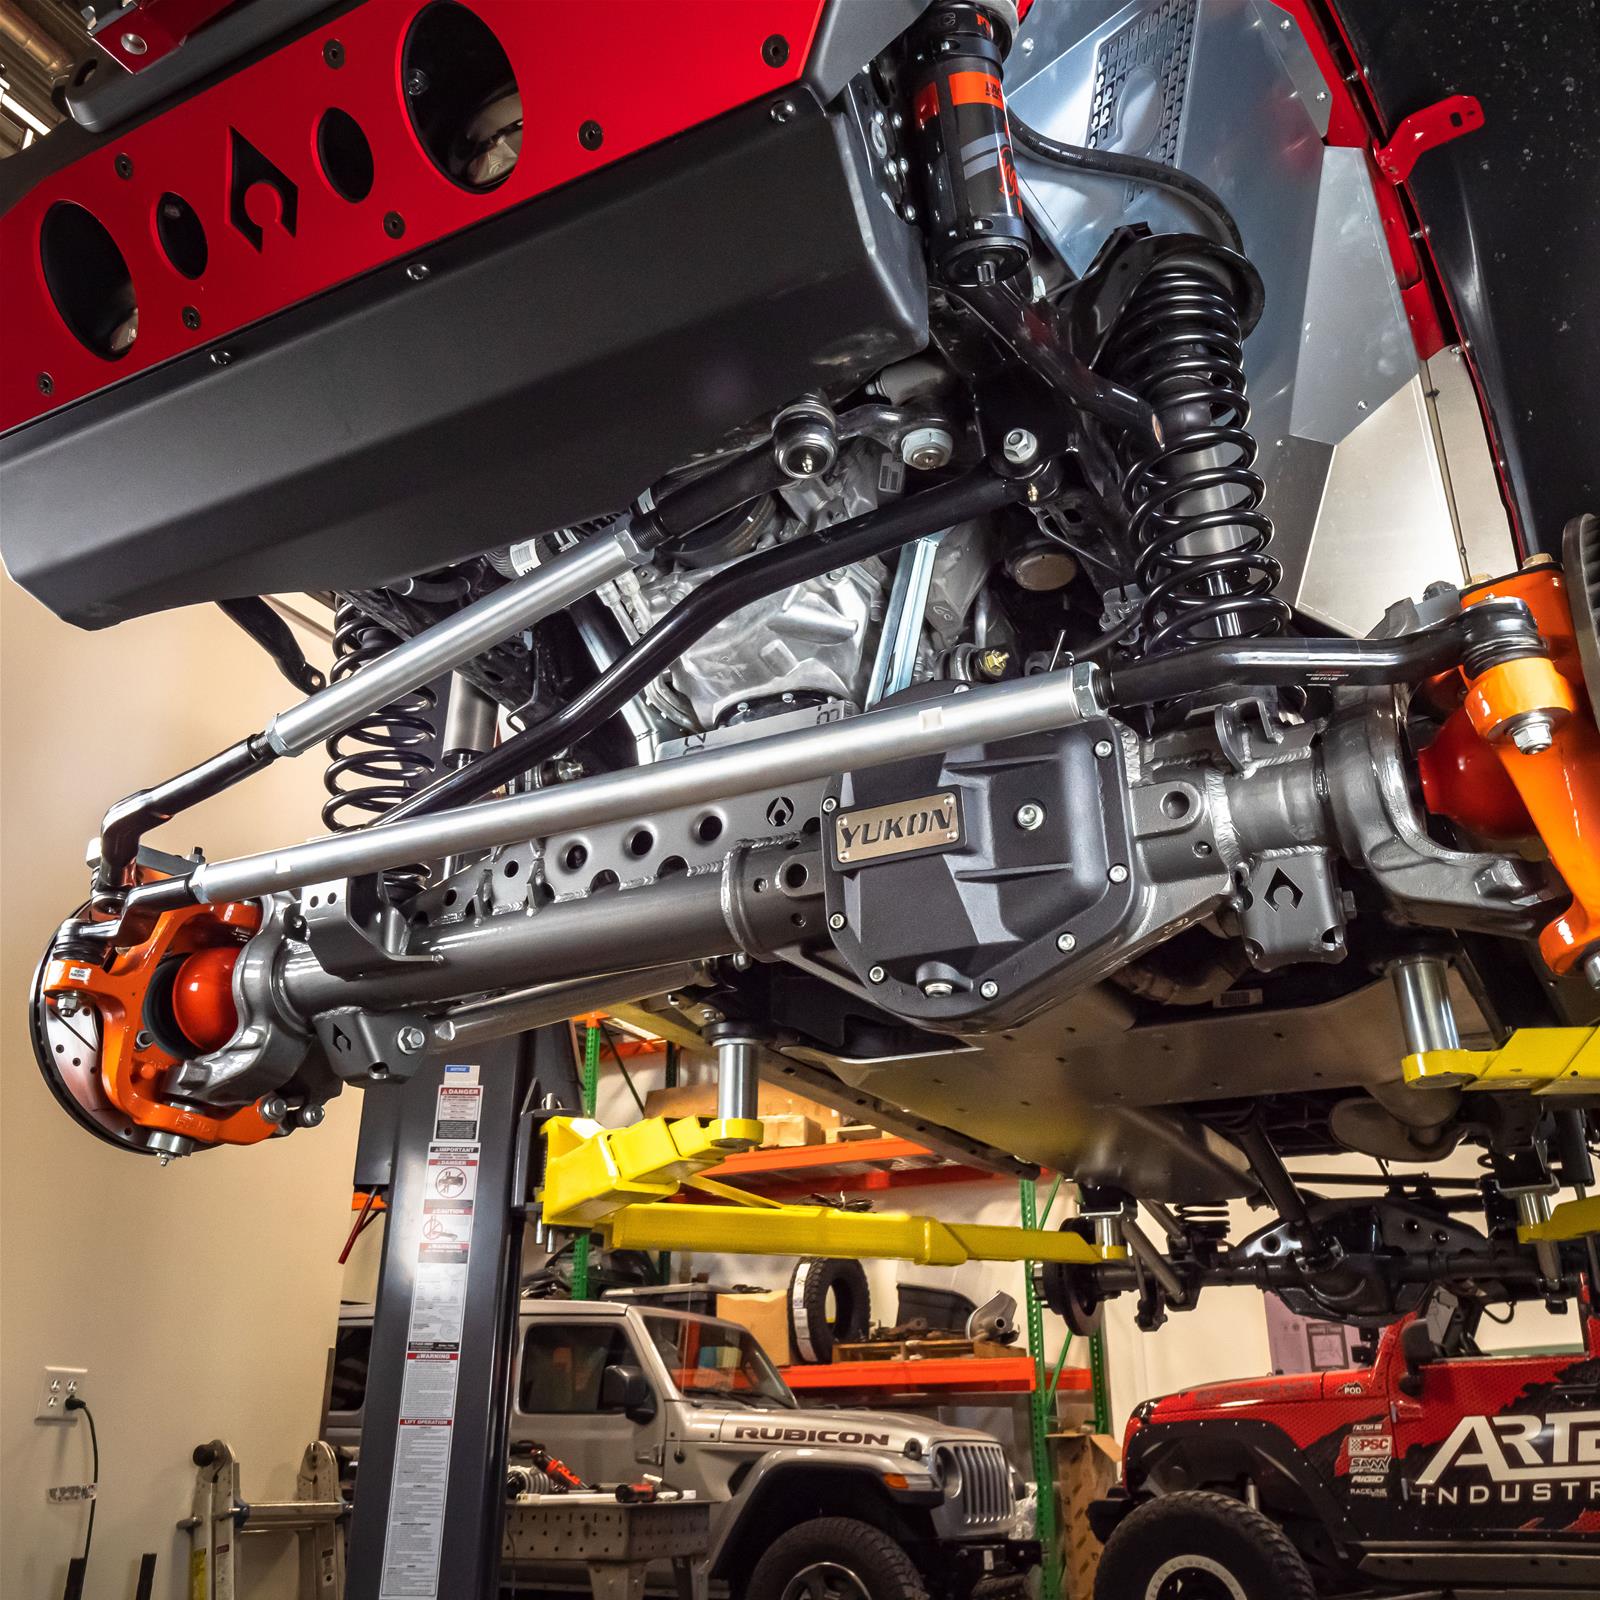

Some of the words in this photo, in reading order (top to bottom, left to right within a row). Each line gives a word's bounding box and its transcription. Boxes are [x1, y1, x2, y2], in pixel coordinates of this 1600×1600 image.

[840, 806, 953, 849] YUKON
[1344, 1386, 1362, 1395] POD
[735, 1426, 890, 1446] RUBICON
[1360, 1438, 1389, 1450] PSC
